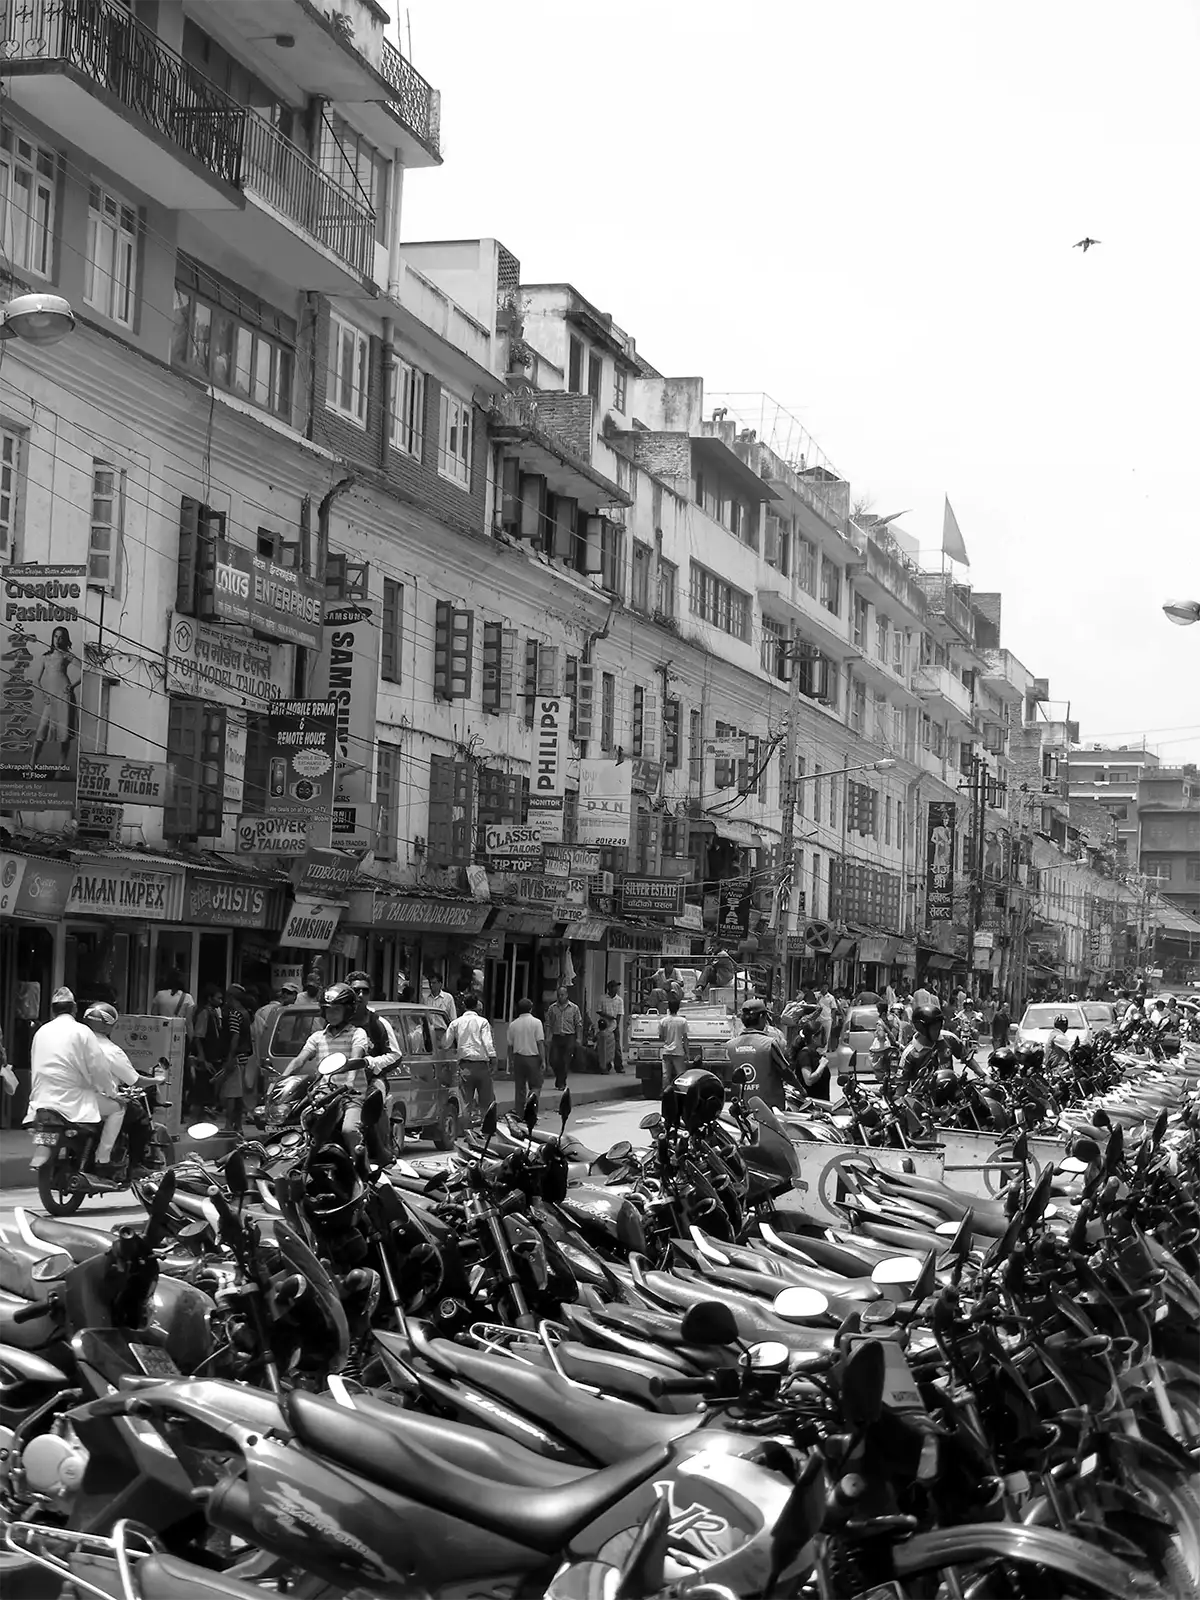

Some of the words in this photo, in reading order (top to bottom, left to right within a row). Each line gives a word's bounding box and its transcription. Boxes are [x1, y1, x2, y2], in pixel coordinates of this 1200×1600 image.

[5, 580, 81, 599] Creative
[254, 575, 321, 627] ENTERPRISE
[6, 603, 79, 621] Fashion
[13, 622, 25, 632] &
[172, 655, 199, 678] TOP
[236, 673, 277, 700] TAILORS
[286, 702, 312, 716] MOBILE
[312, 702, 335, 716] REPAIR
[277, 732, 303, 745] REMOTE
[304, 732, 327, 745] HOUSE
[537, 701, 560, 790] PHILIPS
[34, 763, 70, 771] Kathmandu
[118, 779, 160, 797] TAILORS
[530, 799, 560, 807] MONITOR
[93, 815, 113, 824] PCO
[257, 838, 306, 851] TAILORS
[486, 829, 540, 850] CLASSIC
[508, 844, 540, 853] TAILORS
[595, 837, 626, 846] 2012249
[305, 863, 352, 883] VIDEOCON
[493, 859, 511, 870] TIP
[512, 860, 532, 871] TOP
[71, 876, 117, 904] AMAN
[119, 879, 166, 908] IMPEX
[625, 882, 650, 897] SILVER
[651, 883, 677, 897] ESTATE
[212, 886, 265, 914] MISI'S
[386, 903, 426, 922] TAILORS
[430, 906, 471, 926] DRAPERS
[287, 916, 334, 940] SAMSUNG
